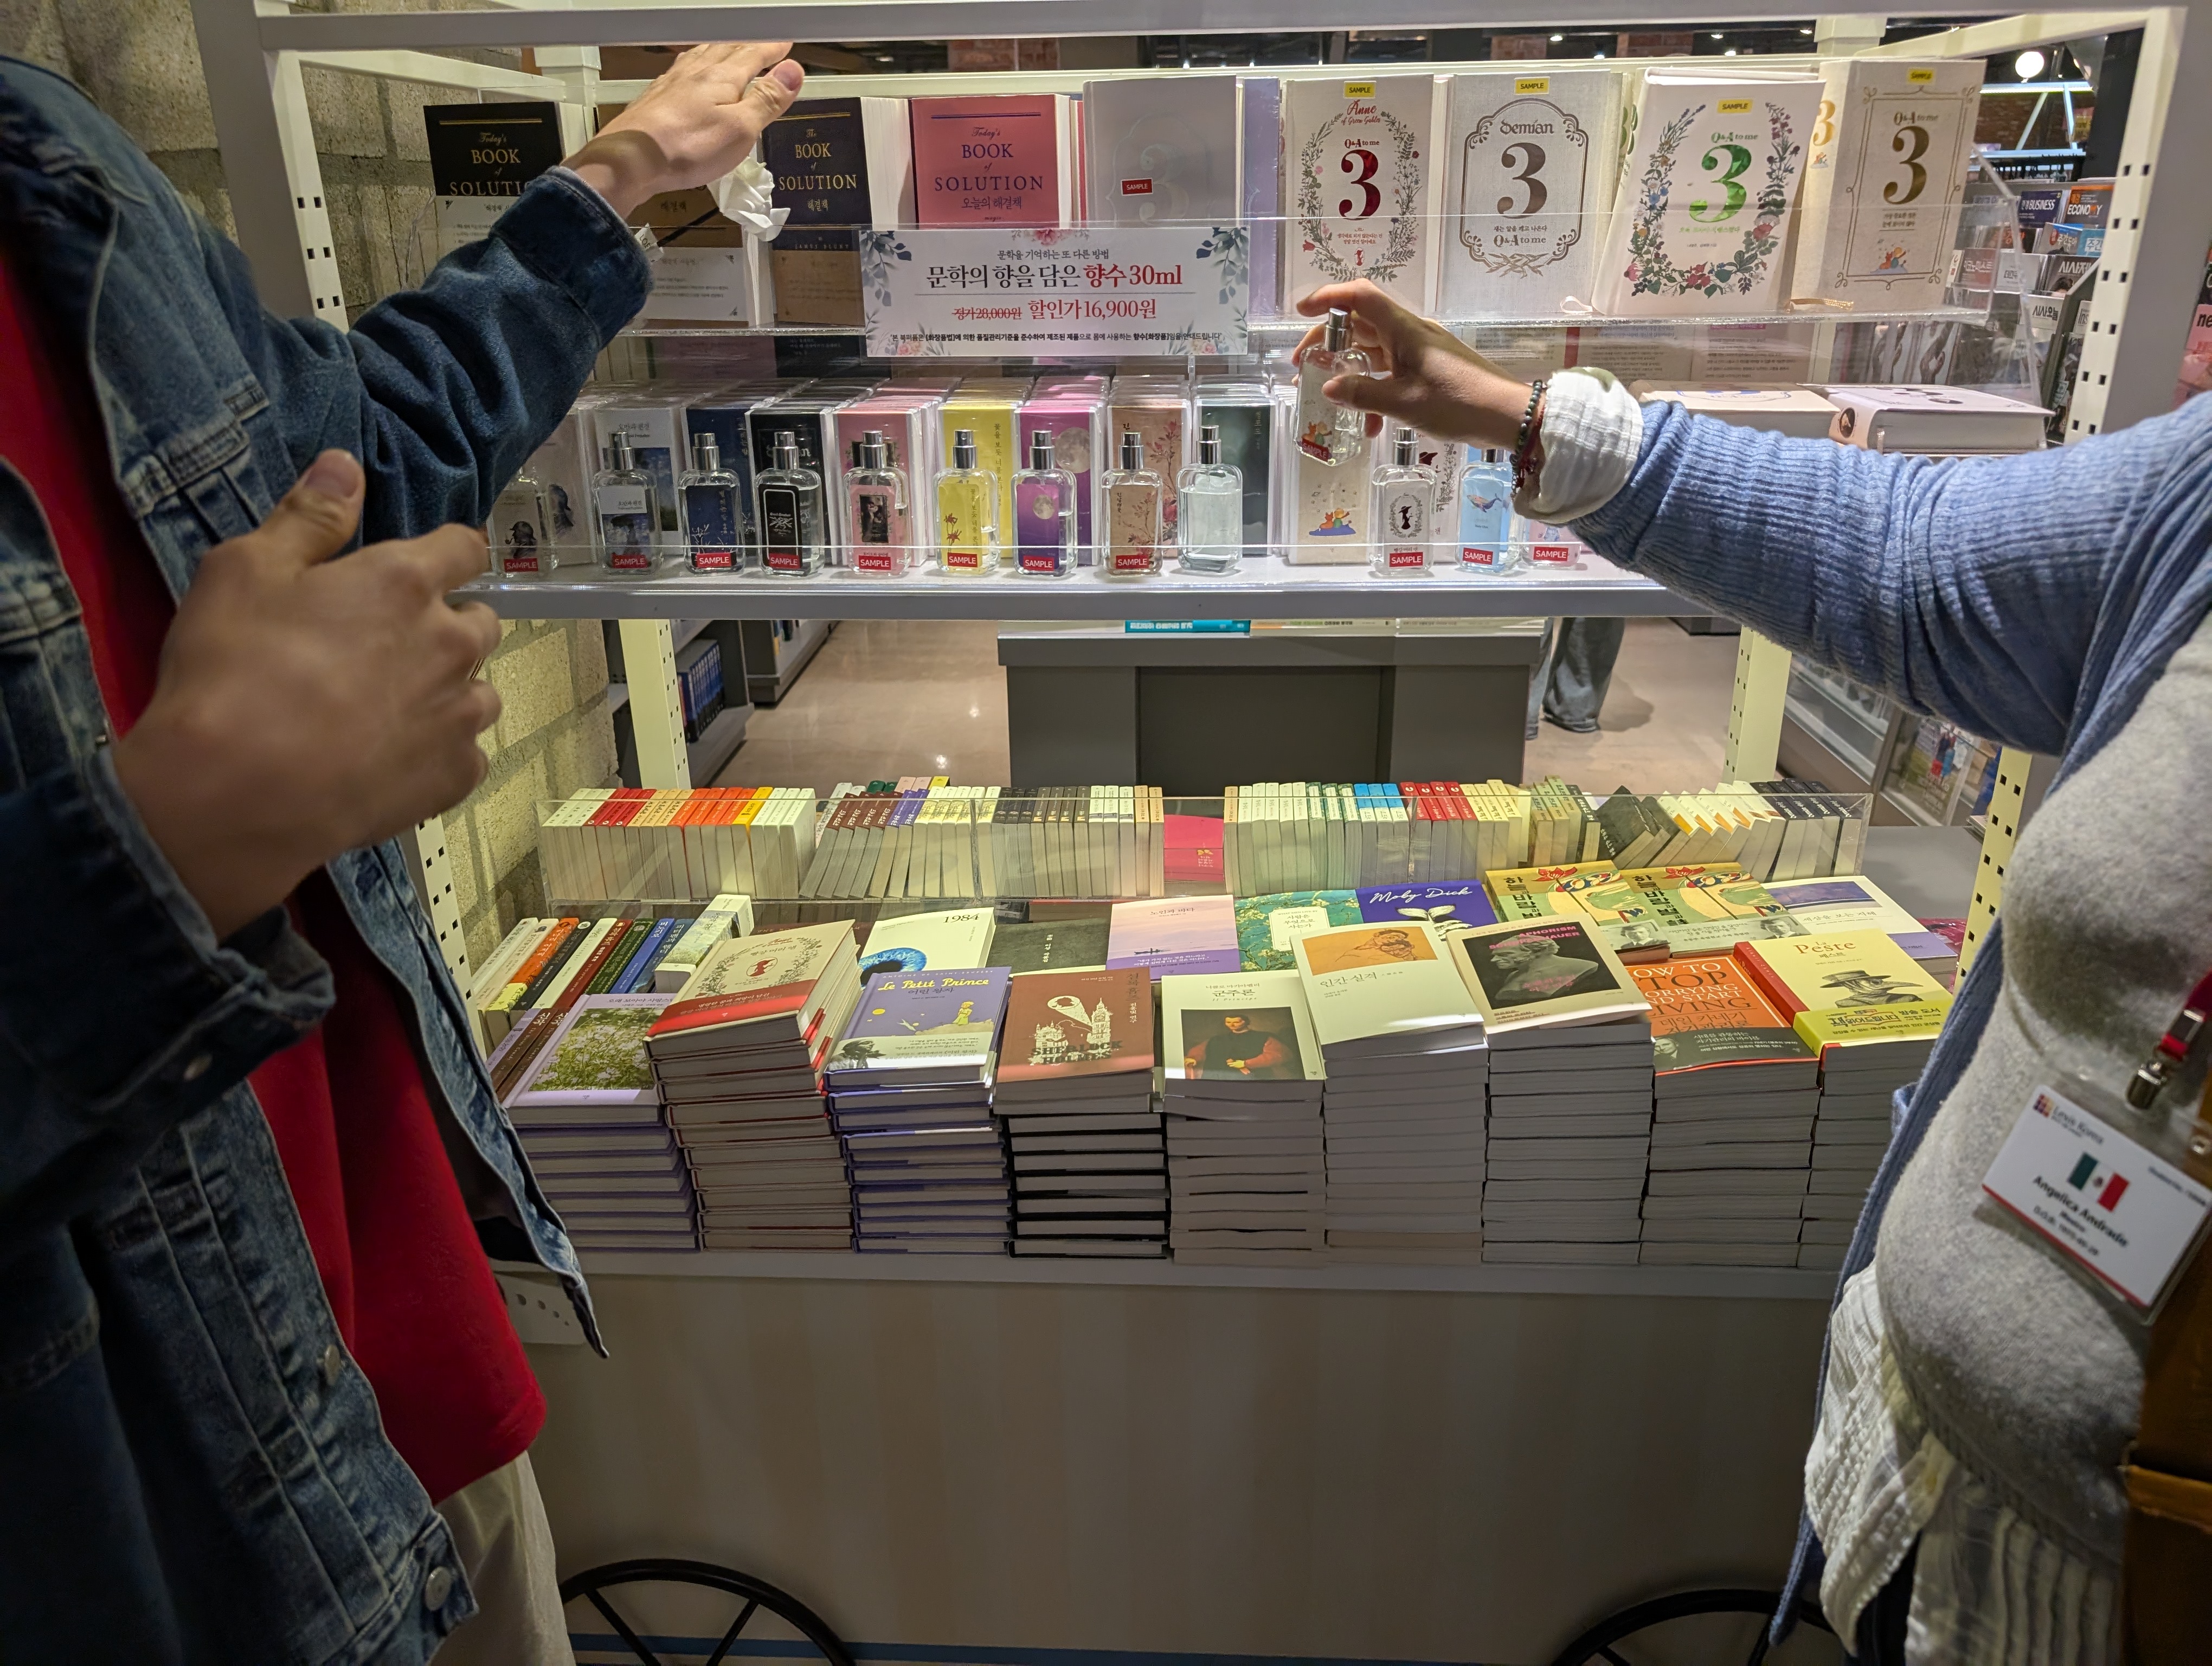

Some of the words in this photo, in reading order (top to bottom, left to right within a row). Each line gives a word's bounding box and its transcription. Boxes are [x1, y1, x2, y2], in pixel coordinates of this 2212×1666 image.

[1520, 82, 1545, 91] SAMPLE
[1347, 99, 1377, 115] Anne
[1722, 101, 1748, 111] SAMPLE
[1348, 117, 1363, 125] Green
[1364, 115, 1381, 125] Gables
[972, 126, 1001, 138] Today's
[471, 149, 521, 164] BOOK
[795, 143, 832, 159] BOOK
[962, 144, 1013, 158] BOOK
[1883, 126, 1930, 205] 3
[779, 174, 857, 191] SOLUTION
[935, 176, 1043, 191] SOLUTION
[1126, 183, 1149, 191] SAMPLE
[1339, 149, 1381, 221] 3
[1497, 142, 1548, 220] 3
[1689, 144, 1752, 222] 3
[807, 199, 828, 212] 해결책
[962, 196, 991, 210] 오늘의
[993, 196, 1021, 210] 해결책
[2029, 200, 2055, 210] BUSINESS
[1494, 234, 1519, 247] Q&A
[997, 250, 1024, 260] 문학을
[1025, 249, 1060, 260] 기억하는
[1062, 250, 1071, 259] 또
[1073, 249, 1090, 259] 다른
[1092, 249, 1109, 259] 방법
[926, 265, 988, 289] 문학의
[992, 265, 1036, 289] 향을
[1039, 264, 1081, 288] 담은
[1083, 264, 1127, 287] 향수
[1129, 265, 1182, 285] 30ml
[1028, 299, 1082, 319] 할인가
[1084, 299, 1156, 321] 16,900원
[2033, 305, 2059, 321] 시사오늘
[1303, 443, 1327, 459] SAMPLE
[615, 558, 645, 566] SAMPLE
[770, 558, 798, 566] SAMPLE
[860, 559, 890, 567] SAMPLE
[949, 556, 976, 564] SAMPLE
[1025, 559, 1053, 568] SAMPLE
[1391, 556, 1422, 564] SAMPLE
[1464, 551, 1492, 562] SAMPLE
[1504, 876, 1529, 894] 하늘과
[1632, 875, 1660, 890] 하늘과
[1369, 889, 1423, 904] Moby
[1425, 887, 1472, 899] Dick
[1644, 890, 1674, 908] 바람과
[1513, 894, 1540, 912] 바람과
[944, 913, 980, 924] 1984
[651, 921, 669, 938] 피노키오
[1519, 926, 1577, 937] APHORISM
[660, 944, 672, 953] 웬디
[1793, 943, 1856, 954] Peste
[1628, 966, 1675, 978] OW
[1682, 963, 1721, 973] TO
[878, 982, 895, 991] Le
[901, 980, 935, 989] Petit
[941, 978, 989, 987] Prince
[1320, 977, 1348, 988] 인간
[1349, 972, 1377, 983] 실격
[1645, 984, 1738, 998] ORRYING
[1647, 996, 1674, 1004] ND
[1682, 990, 1742, 1002] START
[533, 1012, 550, 1026] 신곡
[1660, 1016, 1690, 1026] 데일
[1696, 1011, 1747, 1022] 카네기
[1032, 1040, 1123, 1056] SHERLOCK
